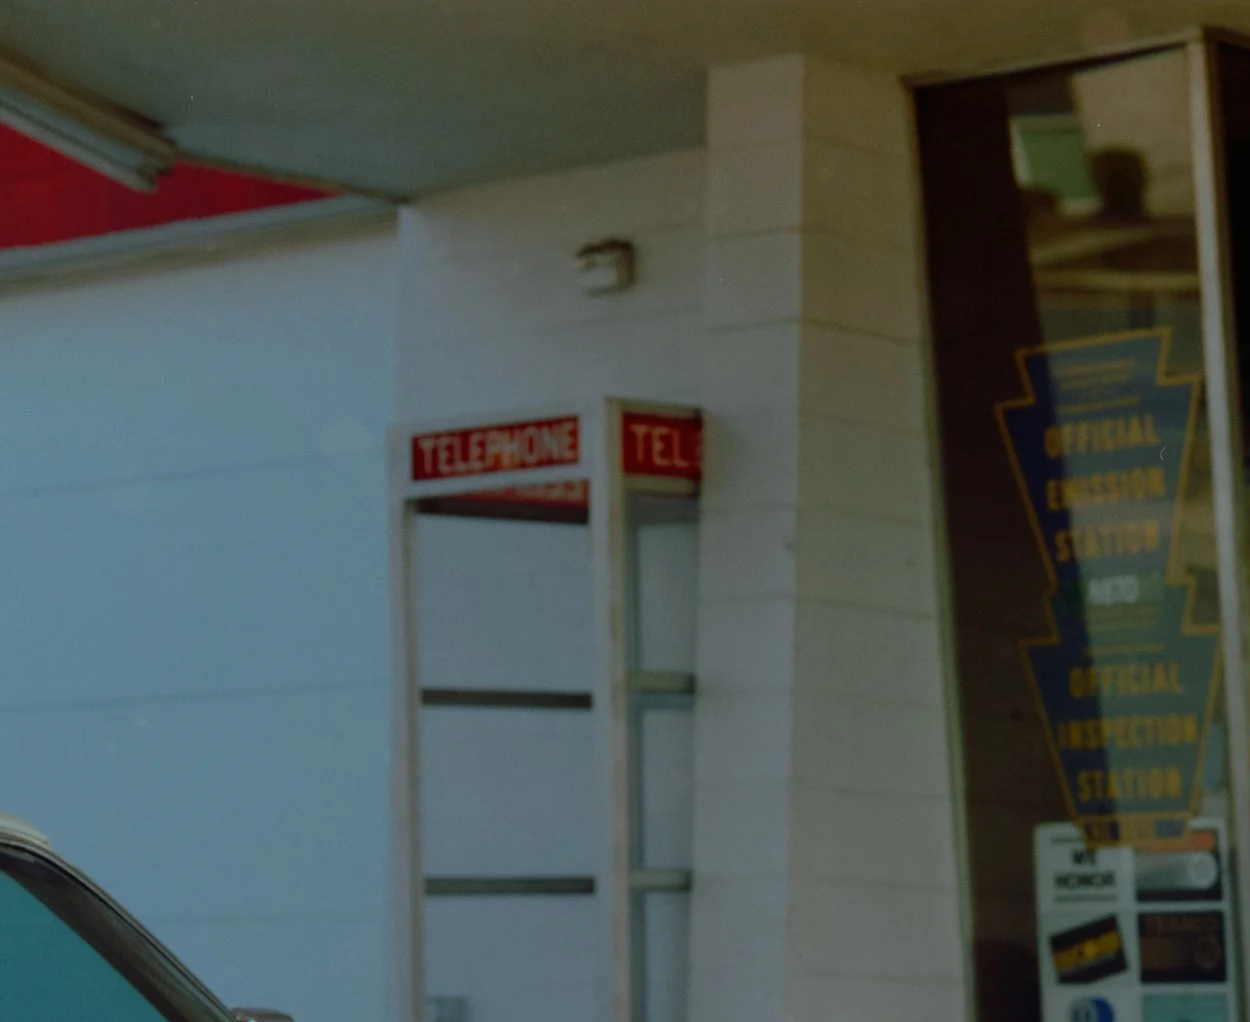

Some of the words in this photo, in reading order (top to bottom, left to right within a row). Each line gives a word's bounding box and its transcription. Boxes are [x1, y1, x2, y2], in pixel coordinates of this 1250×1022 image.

[417, 422, 576, 475] TELEPHONE
[629, 423, 701, 468] TEL
[1043, 412, 1160, 458] OFFICIAL
[1045, 465, 1166, 512] EMISSION
[1053, 516, 1160, 565] STATION
[1067, 660, 1184, 699] OFFICIAL
[1057, 712, 1198, 750] INSPECTION
[1076, 764, 1184, 804] STATION
[1053, 871, 1116, 889] HONOR
